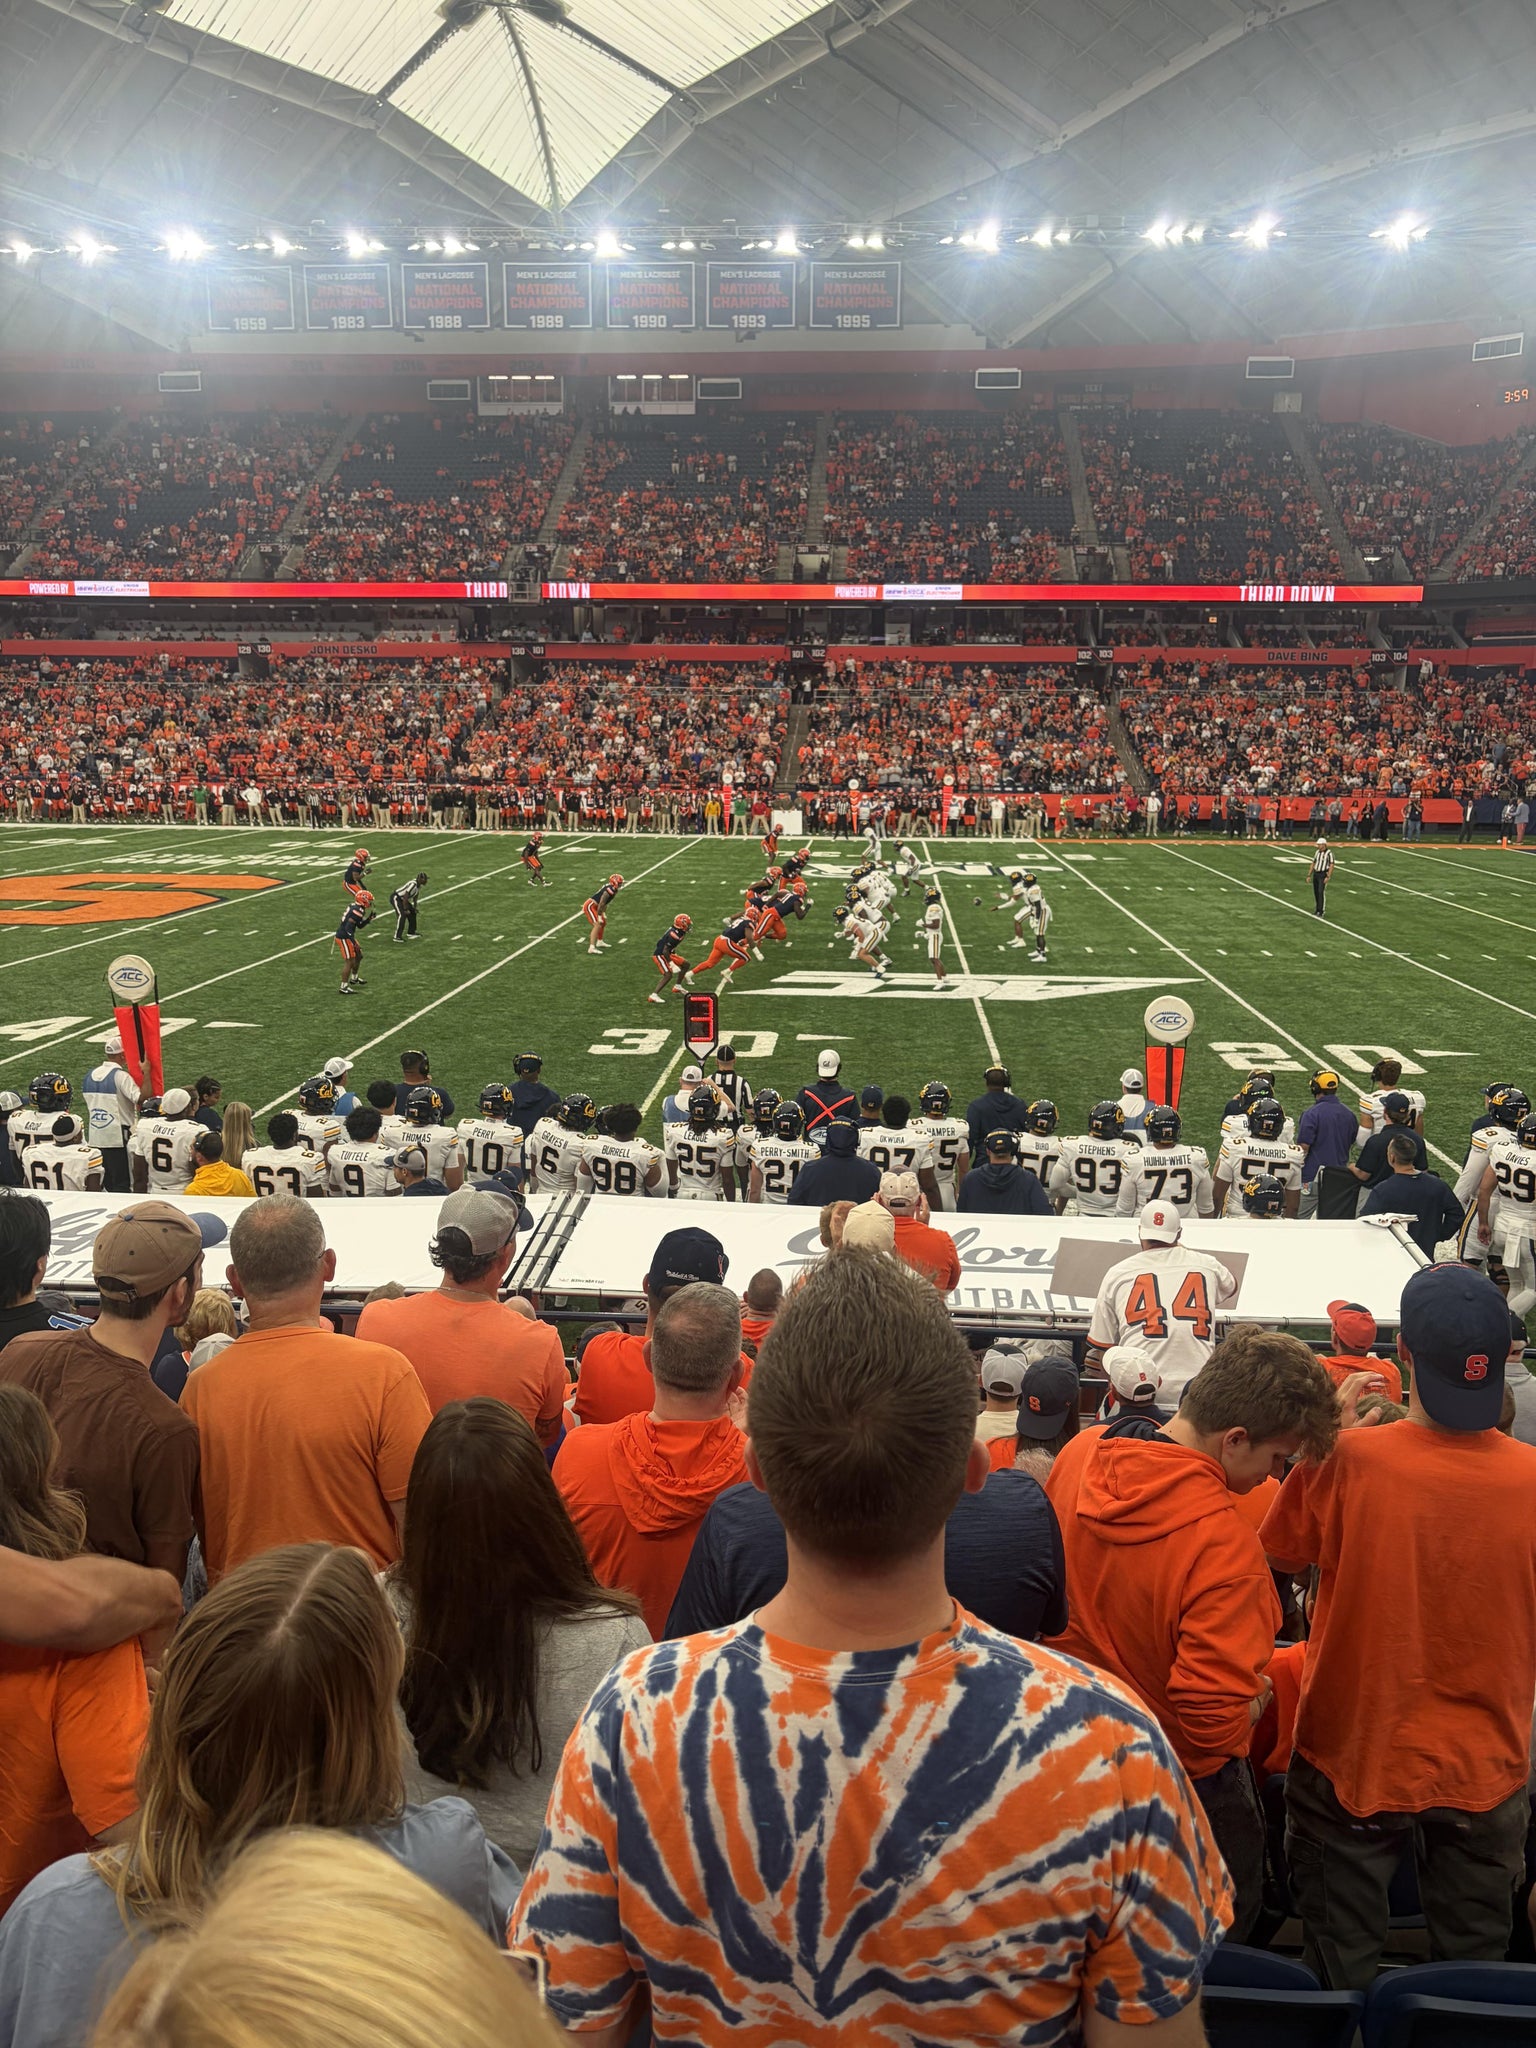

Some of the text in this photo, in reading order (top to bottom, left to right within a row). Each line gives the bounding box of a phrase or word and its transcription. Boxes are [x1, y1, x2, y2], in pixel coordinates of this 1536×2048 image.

[317, 272, 376, 281] MEN'S LACROSSE
[415, 271, 475, 280] MEN'S LACROSSE
[516, 271, 577, 279] MEN'S LACROSSE
[620, 270, 681, 279] MEN'S LACROSSE
[720, 270, 782, 279] MEN'S LACROSSE
[849, 270, 886, 278] LACROSSE
[317, 283, 379, 297] NATIONAL
[415, 283, 477, 296] NATIONAL
[516, 282, 580, 295] NATIONAL
[619, 282, 683, 295] NATIONAL
[719, 282, 784, 295] NATIONAL
[823, 282, 888, 295] NATIONAL
[311, 297, 385, 310] CHAMPIONS
[409, 296, 484, 309] CHAMPIONS
[510, 296, 586, 309] CHAMPIONS
[612, 296, 689, 309] CHAMPIONS
[712, 296, 790, 309] CHAMPIONS
[816, 296, 894, 309] CHAMPIONS
[233, 317, 267, 330] 1959
[331, 316, 365, 329] 1983
[428, 315, 463, 329] 1988
[529, 315, 564, 328] 1989
[632, 315, 667, 328] 1990
[731, 315, 766, 328] 1993
[835, 315, 871, 328] 1995
[1504, 388, 1529, 403] 3:59
[29, 583, 69, 594] POWERED BY
[464, 582, 508, 598] THIRD
[549, 583, 591, 599] DOWN
[835, 586, 878, 598] POWERED BY
[1239, 585, 1336, 602] THIRD DOWN
[257, 645, 271, 653] 130
[310, 645, 378, 654] JOHN DESKO
[511, 647, 526, 656] 130
[532, 646, 545, 655] 101
[792, 650, 805, 659] 101
[812, 648, 826, 658] 102
[1077, 651, 1093, 660] 102
[1099, 650, 1114, 659] 103
[1267, 652, 1328, 661] DAVE BING
[1372, 653, 1387, 663] 103
[1393, 651, 1408, 661] 104
[117, 971, 143, 982] ACC
[690, 996, 714, 1042] 3
[1156, 1015, 1183, 1025] ACC
[588, 1028, 779, 1057] 30
[1208, 1041, 1428, 1075] 20
[54, 1079, 69, 1094] Cal
[318, 1085, 334, 1099] Cal
[502, 1088, 513, 1101] Cal
[584, 1103, 597, 1118] Cal
[402, 1131, 432, 1143] THOMAS
[472, 1127, 496, 1140] PERRY
[151, 1137, 174, 1172] 6
[601, 1144, 630, 1158] BURRELL
[760, 1147, 810, 1159] PERRY-SMITH
[937, 1139, 960, 1170] 5
[1078, 1144, 1116, 1156] STEPHENS
[1247, 1145, 1286, 1159] McMORRIS
[466, 1138, 504, 1176] 10
[540, 1145, 560, 1174] 6
[677, 1142, 717, 1178] 25
[869, 1146, 916, 1172] 97
[1143, 1153, 1192, 1167] HUIHUI-WHITE
[1505, 1152, 1531, 1166] DAVIES
[30, 1160, 64, 1191] 61
[592, 1157, 637, 1194] 98
[764, 1160, 800, 1193] 21
[1018, 1153, 1059, 1188] 50
[1074, 1157, 1122, 1195] 93
[253, 1166, 300, 1197] 63
[343, 1164, 365, 1197] 9
[1143, 1168, 1193, 1205] 73
[1495, 1161, 1536, 1203] 29
[1153, 1211, 1164, 1226] S
[948, 1287, 1089, 1312] OTBALL
[1125, 1272, 1213, 1341] 44
[1464, 1354, 1489, 1381] S
[1028, 1395, 1041, 1412] S
